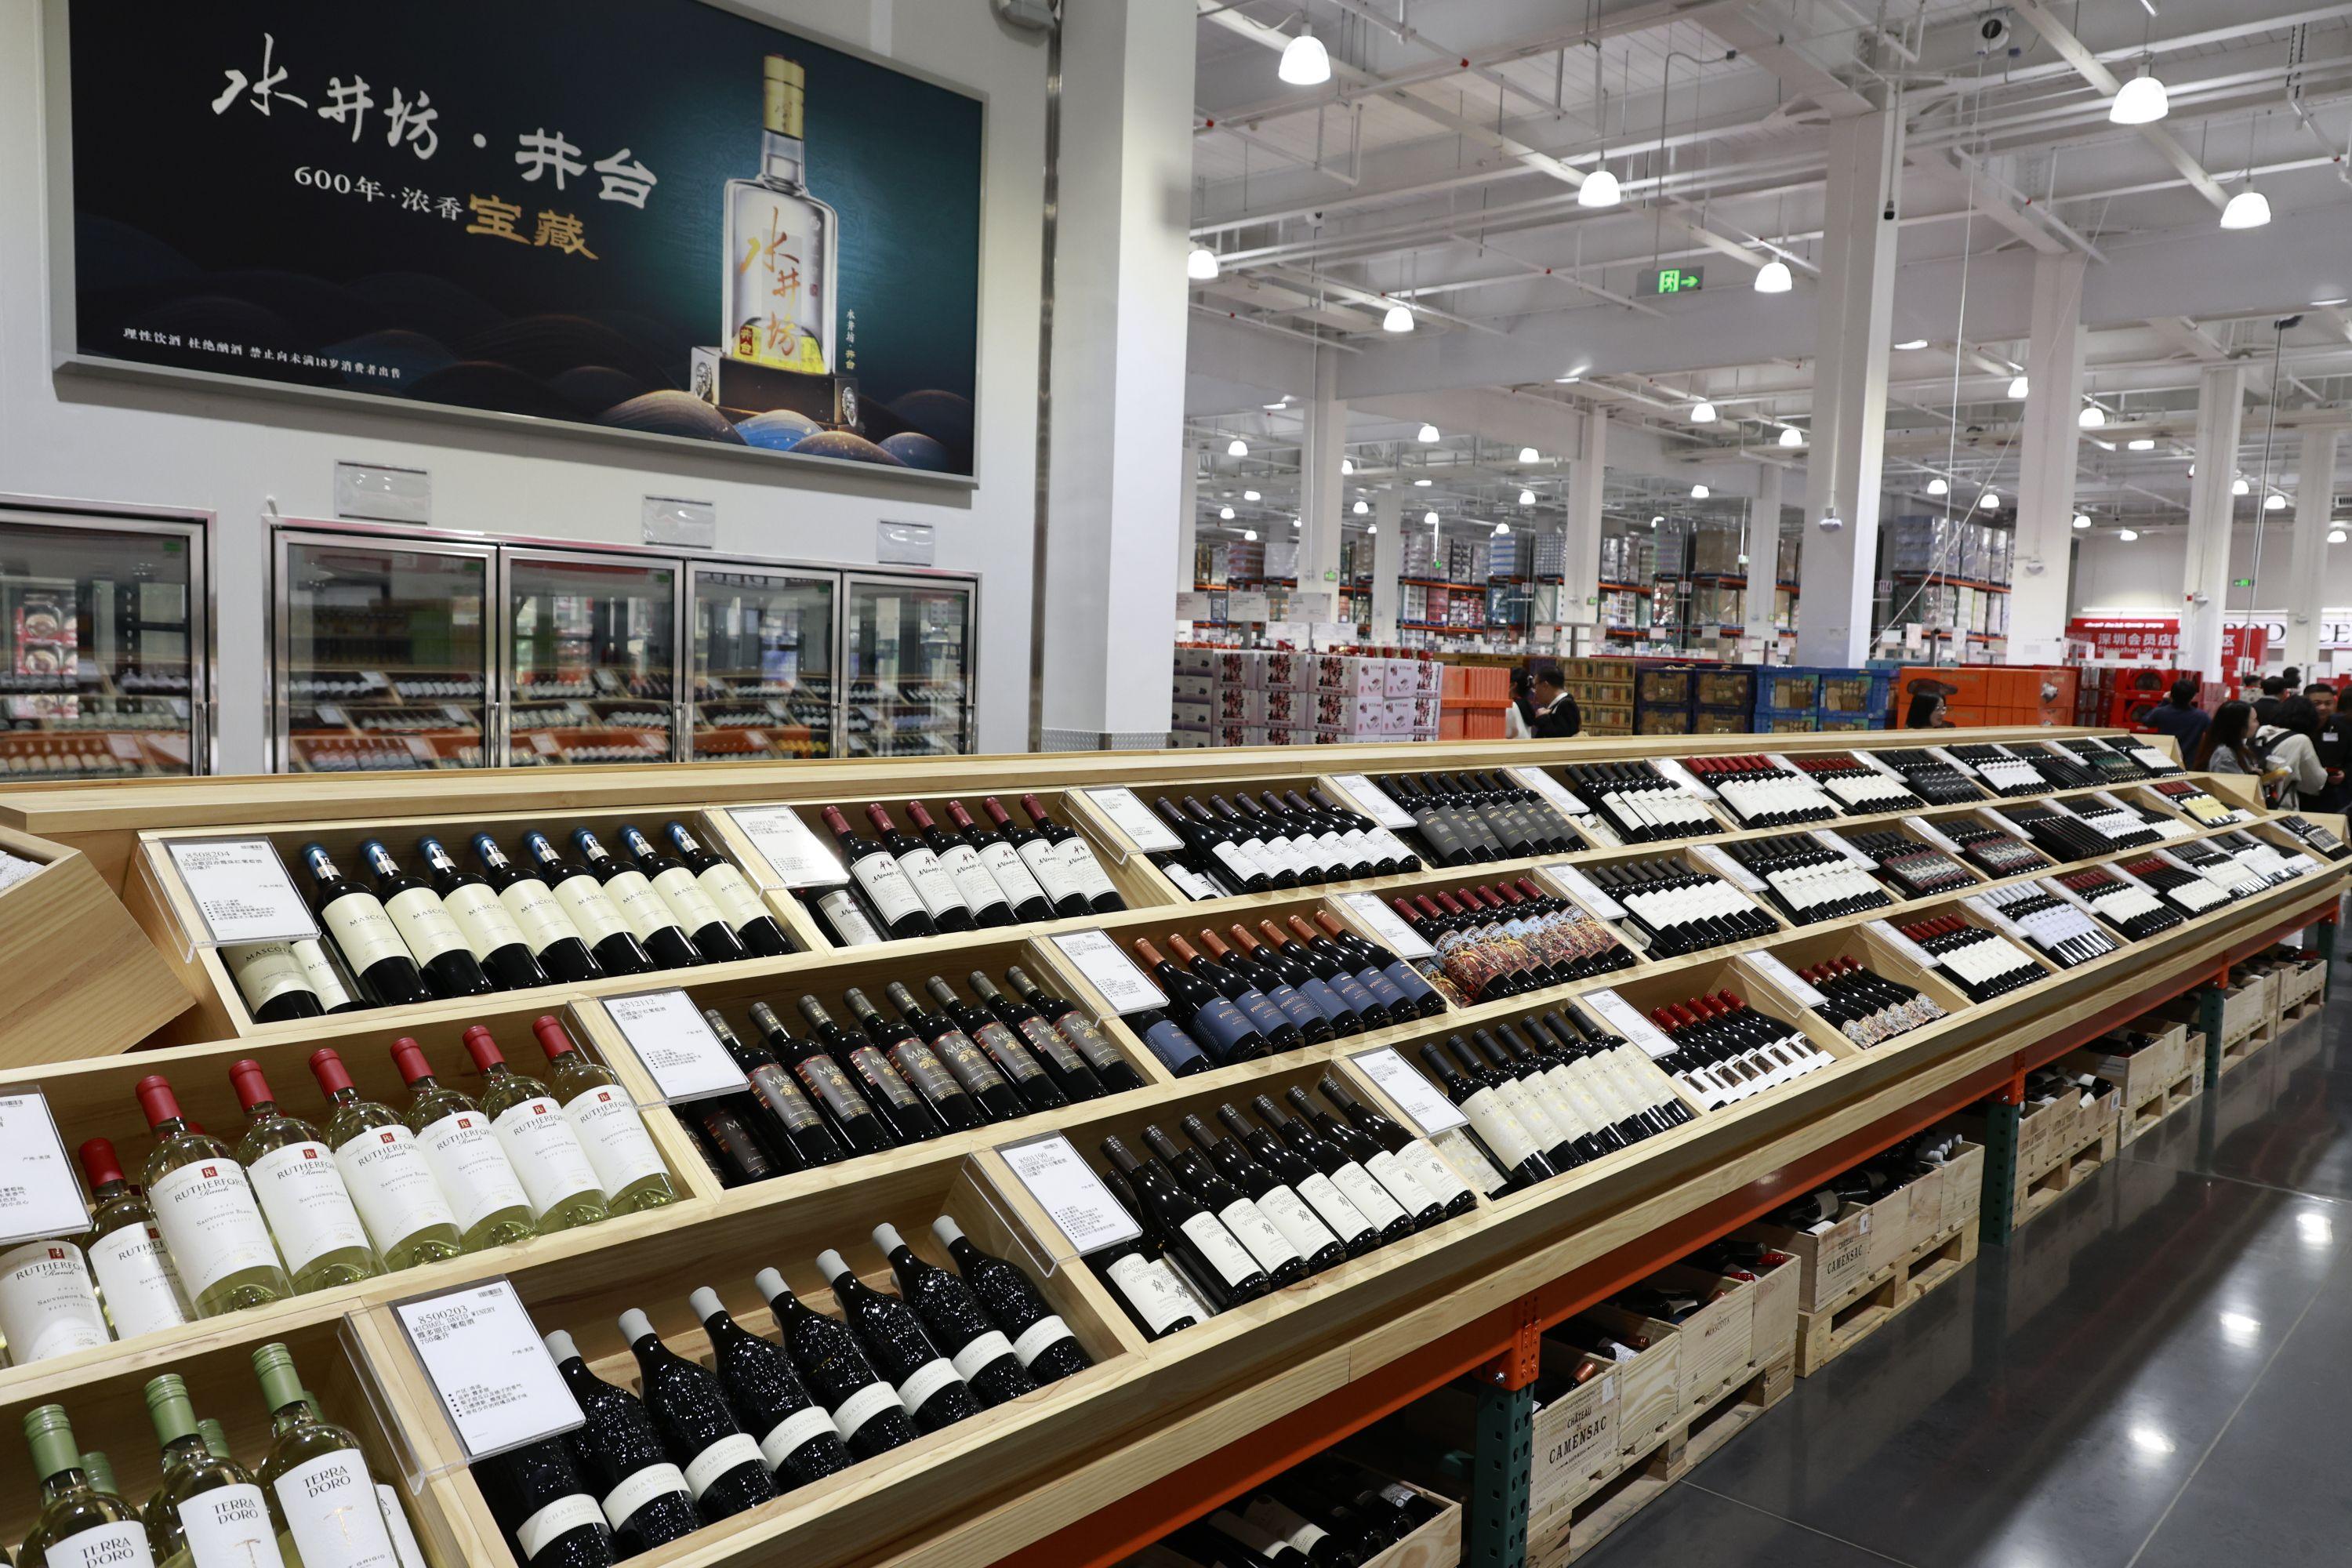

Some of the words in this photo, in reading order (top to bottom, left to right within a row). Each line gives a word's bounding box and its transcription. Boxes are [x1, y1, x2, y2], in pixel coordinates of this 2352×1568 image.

[211, 32, 658, 209] 水井坊·井台
[740, 205, 800, 357] 水井坊
[123, 328, 181, 347] 理性饮酒
[188, 337, 243, 356] 杜绝酗酒
[249, 347, 401, 379] 禁止向未满18岁消费者出售
[1827, 1244, 1863, 1275] CAMENSAC
[413, 1319, 444, 1333] MICHAEL
[448, 1312, 469, 1323] DAVID
[418, 1305, 468, 1325] 8500203
[419, 1332, 450, 1345] 750毫升
[1566, 1407, 1592, 1428] CHÂTEAU
[1548, 1415, 1607, 1465] CAMENSAC
[302, 1465, 349, 1488] TERRA
[309, 1475, 351, 1498] D'ORO
[212, 1498, 256, 1515] TERRA
[218, 1508, 259, 1525] D'ORO
[80, 1537, 132, 1559] TERRA
[85, 1548, 135, 1568] D'ORO
[356, 1553, 386, 1567] GRIGIO
